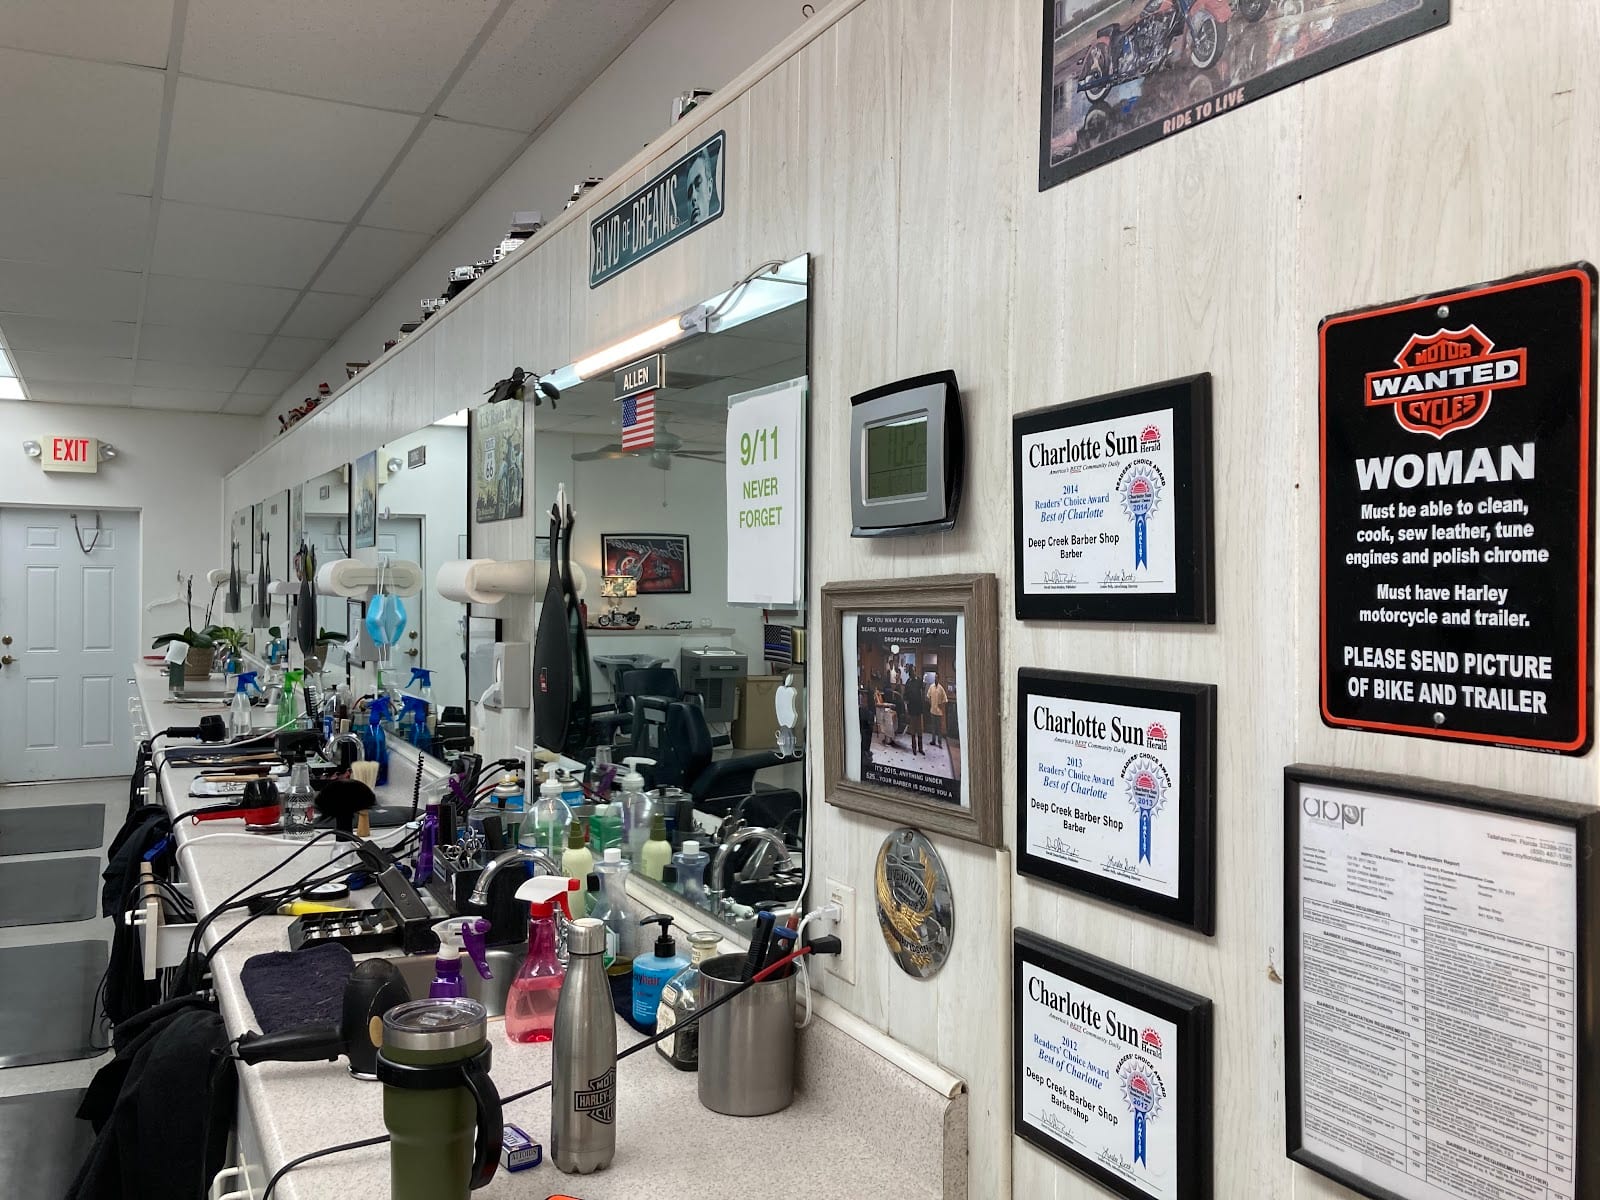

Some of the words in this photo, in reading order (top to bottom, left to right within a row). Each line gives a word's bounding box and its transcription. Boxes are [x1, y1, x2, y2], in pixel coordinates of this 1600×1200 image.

[1163, 111, 1191, 135] RIDE
[1196, 102, 1212, 120] TO
[1216, 87, 1245, 113] LIVE
[594, 215, 620, 274] BLVD
[622, 218, 630, 250] OF
[632, 174, 678, 253] DREAMS
[1416, 339, 1471, 365] MOTOR
[623, 366, 648, 391] ALLEN
[1372, 360, 1518, 396] WANTED
[1409, 394, 1475, 424] CYCLES
[53, 438, 89, 462] EXIT
[740, 425, 778, 466] 9/11
[1029, 437, 1101, 468] Charlotte
[1105, 431, 1138, 458] Sun
[1141, 443, 1160, 453] Herald
[1356, 442, 1535, 490] WOMAN
[743, 477, 778, 499] NEVER
[1063, 485, 1078, 495] 2014
[1035, 497, 1062, 510] Readers'
[1064, 495, 1086, 506] Choice
[1087, 493, 1110, 504] Award
[1361, 503, 1395, 519] Must
[1399, 502, 1416, 518] be
[1420, 500, 1452, 517] able
[1457, 501, 1474, 515] to
[1478, 497, 1528, 515] clean,
[740, 507, 782, 528] FORGET
[1041, 511, 1056, 523] Best
[1058, 511, 1067, 523] of
[1067, 508, 1104, 520] Charlotte
[1028, 536, 1046, 549] Deep
[1048, 536, 1068, 546] Creek
[1072, 534, 1096, 545] Barber
[1099, 532, 1119, 545] Shop
[1357, 526, 1394, 544] cook,
[1398, 528, 1427, 540] sew
[1432, 524, 1491, 541] leather,
[1496, 522, 1534, 538] tune
[1061, 550, 1082, 559] Barber
[1346, 550, 1398, 568] engines
[1402, 549, 1428, 564] and
[1433, 547, 1479, 567] polish
[1484, 546, 1549, 563] chrome
[1377, 584, 1411, 600] Must
[1415, 584, 1450, 600] have
[1455, 585, 1508, 604] Harley
[1360, 608, 1438, 626] motorcycle
[1442, 609, 1470, 625] and
[1475, 609, 1530, 626] trailer.
[1345, 646, 1405, 669] PLEASE
[1411, 650, 1459, 673] SEND
[1465, 653, 1552, 679] PICTURE
[1348, 677, 1368, 697] OF
[1374, 679, 1414, 702] BIKE
[1419, 683, 1456, 705] AND
[1462, 686, 1547, 714] TRAILER
[1033, 705, 1106, 741] Charlotte
[1111, 716, 1144, 746] Sun
[1147, 741, 1167, 750] Herald
[1067, 757, 1083, 768] 2013
[1140, 753, 1158, 764] CHOICE
[899, 771, 923, 780] ANYTHING
[925, 776, 942, 785] UNDER
[1039, 763, 1066, 777] Readers'
[1067, 769, 1091, 781] Choice
[1091, 774, 1114, 786] Award
[893, 779, 911, 788] BARBER
[920, 785, 935, 794] DOING
[1043, 777, 1060, 790] Best
[1061, 780, 1070, 793] of
[1071, 782, 1107, 799] Charlotte
[1139, 798, 1152, 806] 2013
[1031, 798, 1049, 814] Deep
[1051, 803, 1072, 817] Creek
[1075, 808, 1100, 825] Barber
[1103, 812, 1123, 831] Shop
[1063, 820, 1085, 834] Barber
[1028, 976, 1101, 1030] Charlotte
[1106, 1010, 1139, 1048] Sun
[1062, 1036, 1078, 1051] 2012
[1142, 1043, 1162, 1059] Herald
[1033, 1034, 1062, 1055] Readers'
[1063, 1049, 1086, 1068] Choice
[1087, 1060, 1109, 1079] Award
[1135, 1054, 1154, 1069] CHOICE
[1038, 1048, 1054, 1066] Best
[1056, 1056, 1064, 1071] of
[1066, 1061, 1102, 1090] Charlotte
[1026, 1067, 1044, 1086] Deep
[1046, 1076, 1067, 1097] Creek
[1070, 1088, 1096, 1113] Barber
[1098, 1104, 1118, 1127] Shop
[1134, 1098, 1148, 1110] 2012
[1051, 1094, 1089, 1123] Barbershop
